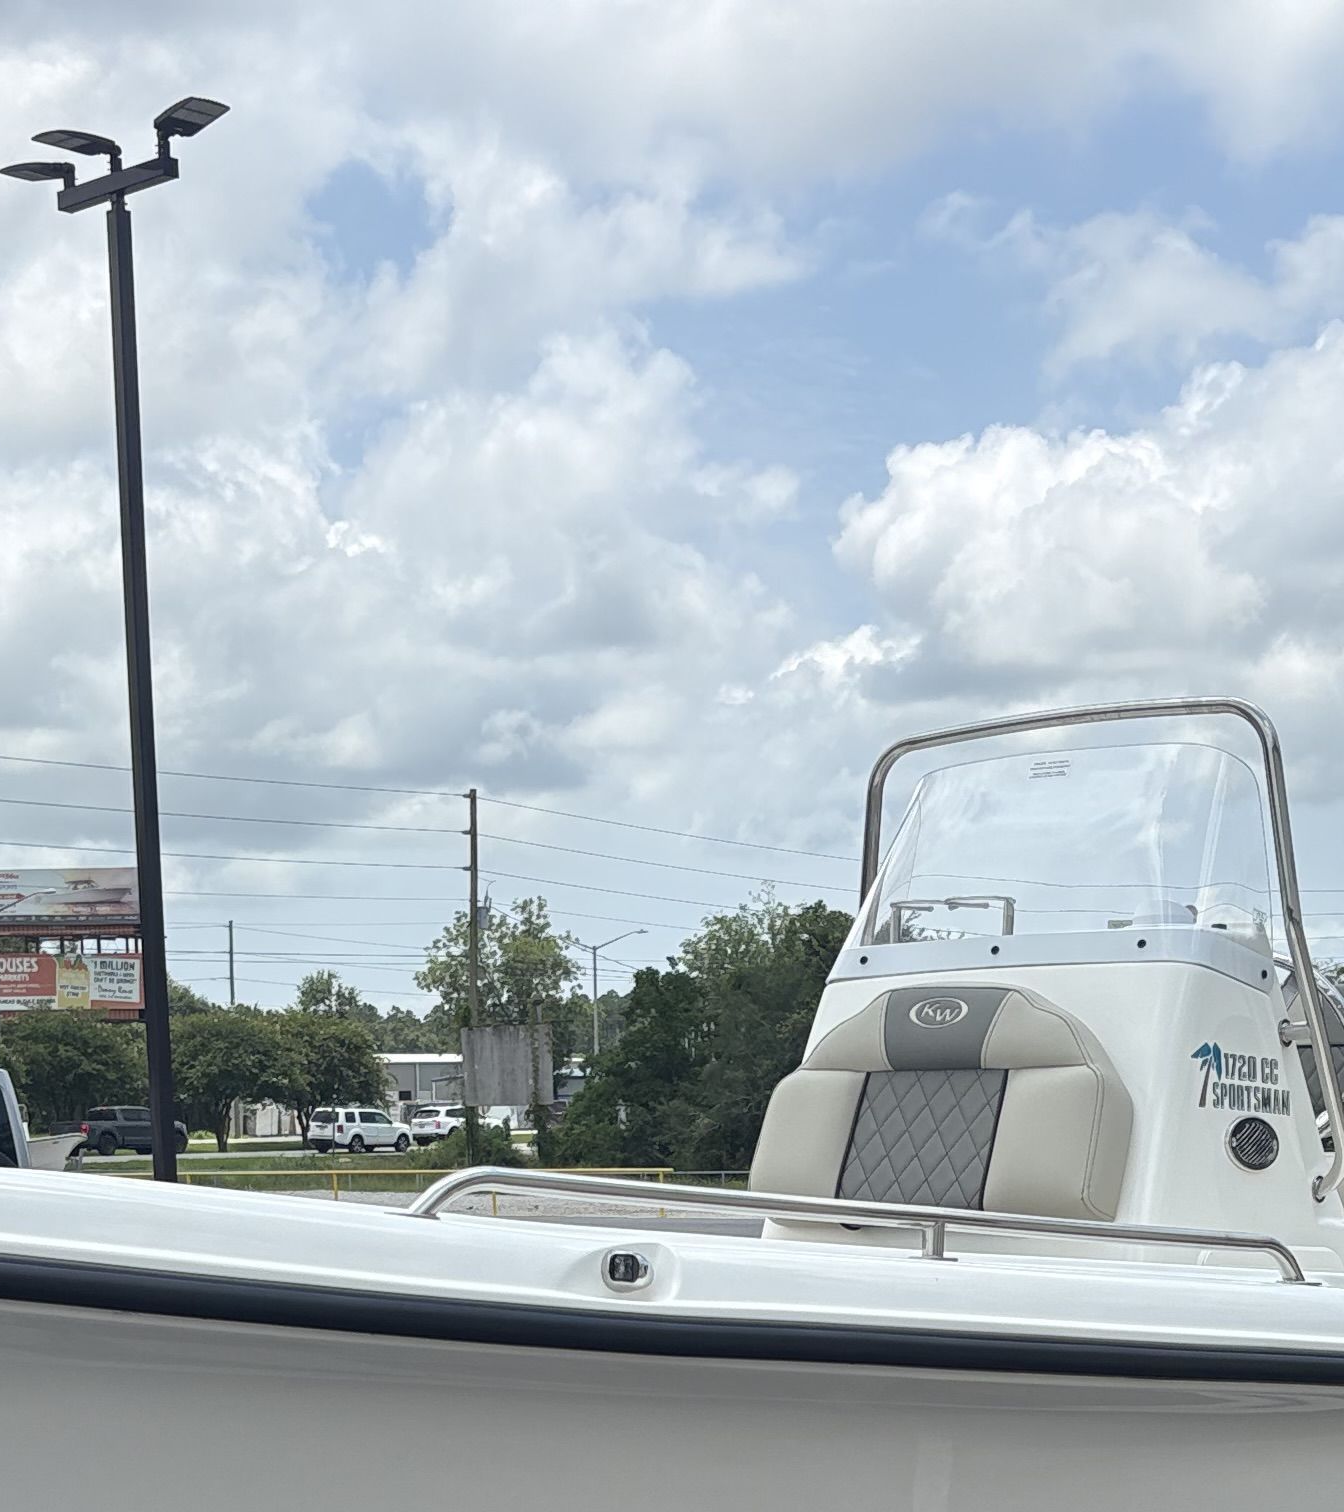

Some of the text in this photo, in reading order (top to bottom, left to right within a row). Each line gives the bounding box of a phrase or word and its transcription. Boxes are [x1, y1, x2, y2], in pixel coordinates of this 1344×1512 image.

[99, 960, 136, 971] MILLION
[1223, 1052, 1279, 1085] 1720 CC
[1212, 1081, 1291, 1117] SPORTSMAN
